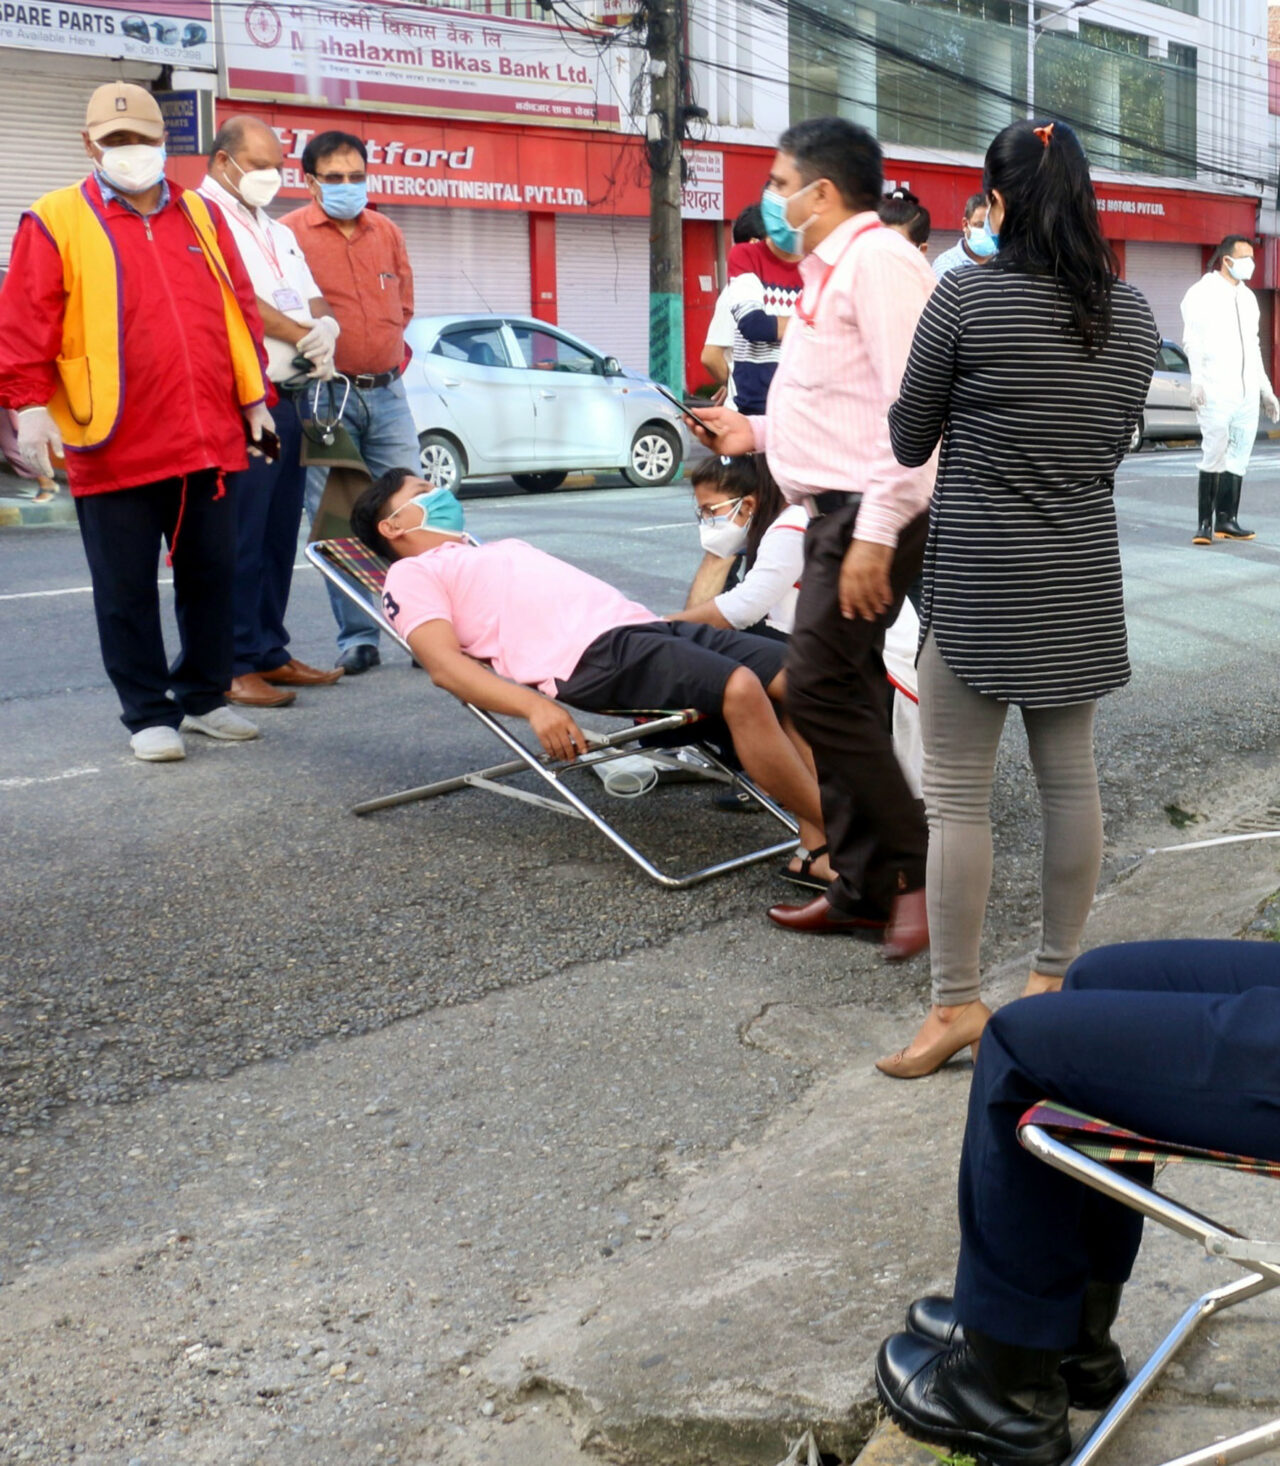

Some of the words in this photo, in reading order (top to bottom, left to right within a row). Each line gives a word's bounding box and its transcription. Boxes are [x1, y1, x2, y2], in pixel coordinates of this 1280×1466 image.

[59, 10, 115, 34] PARTS
[0, 28, 13, 38] re
[17, 29, 65, 43] Available
[69, 34, 95, 46] Here
[431, 49, 492, 73] Bikas
[499, 56, 550, 81] Bank
[557, 63, 593, 84] Ltd.
[366, 176, 522, 203] INTERCONTINENTAL
